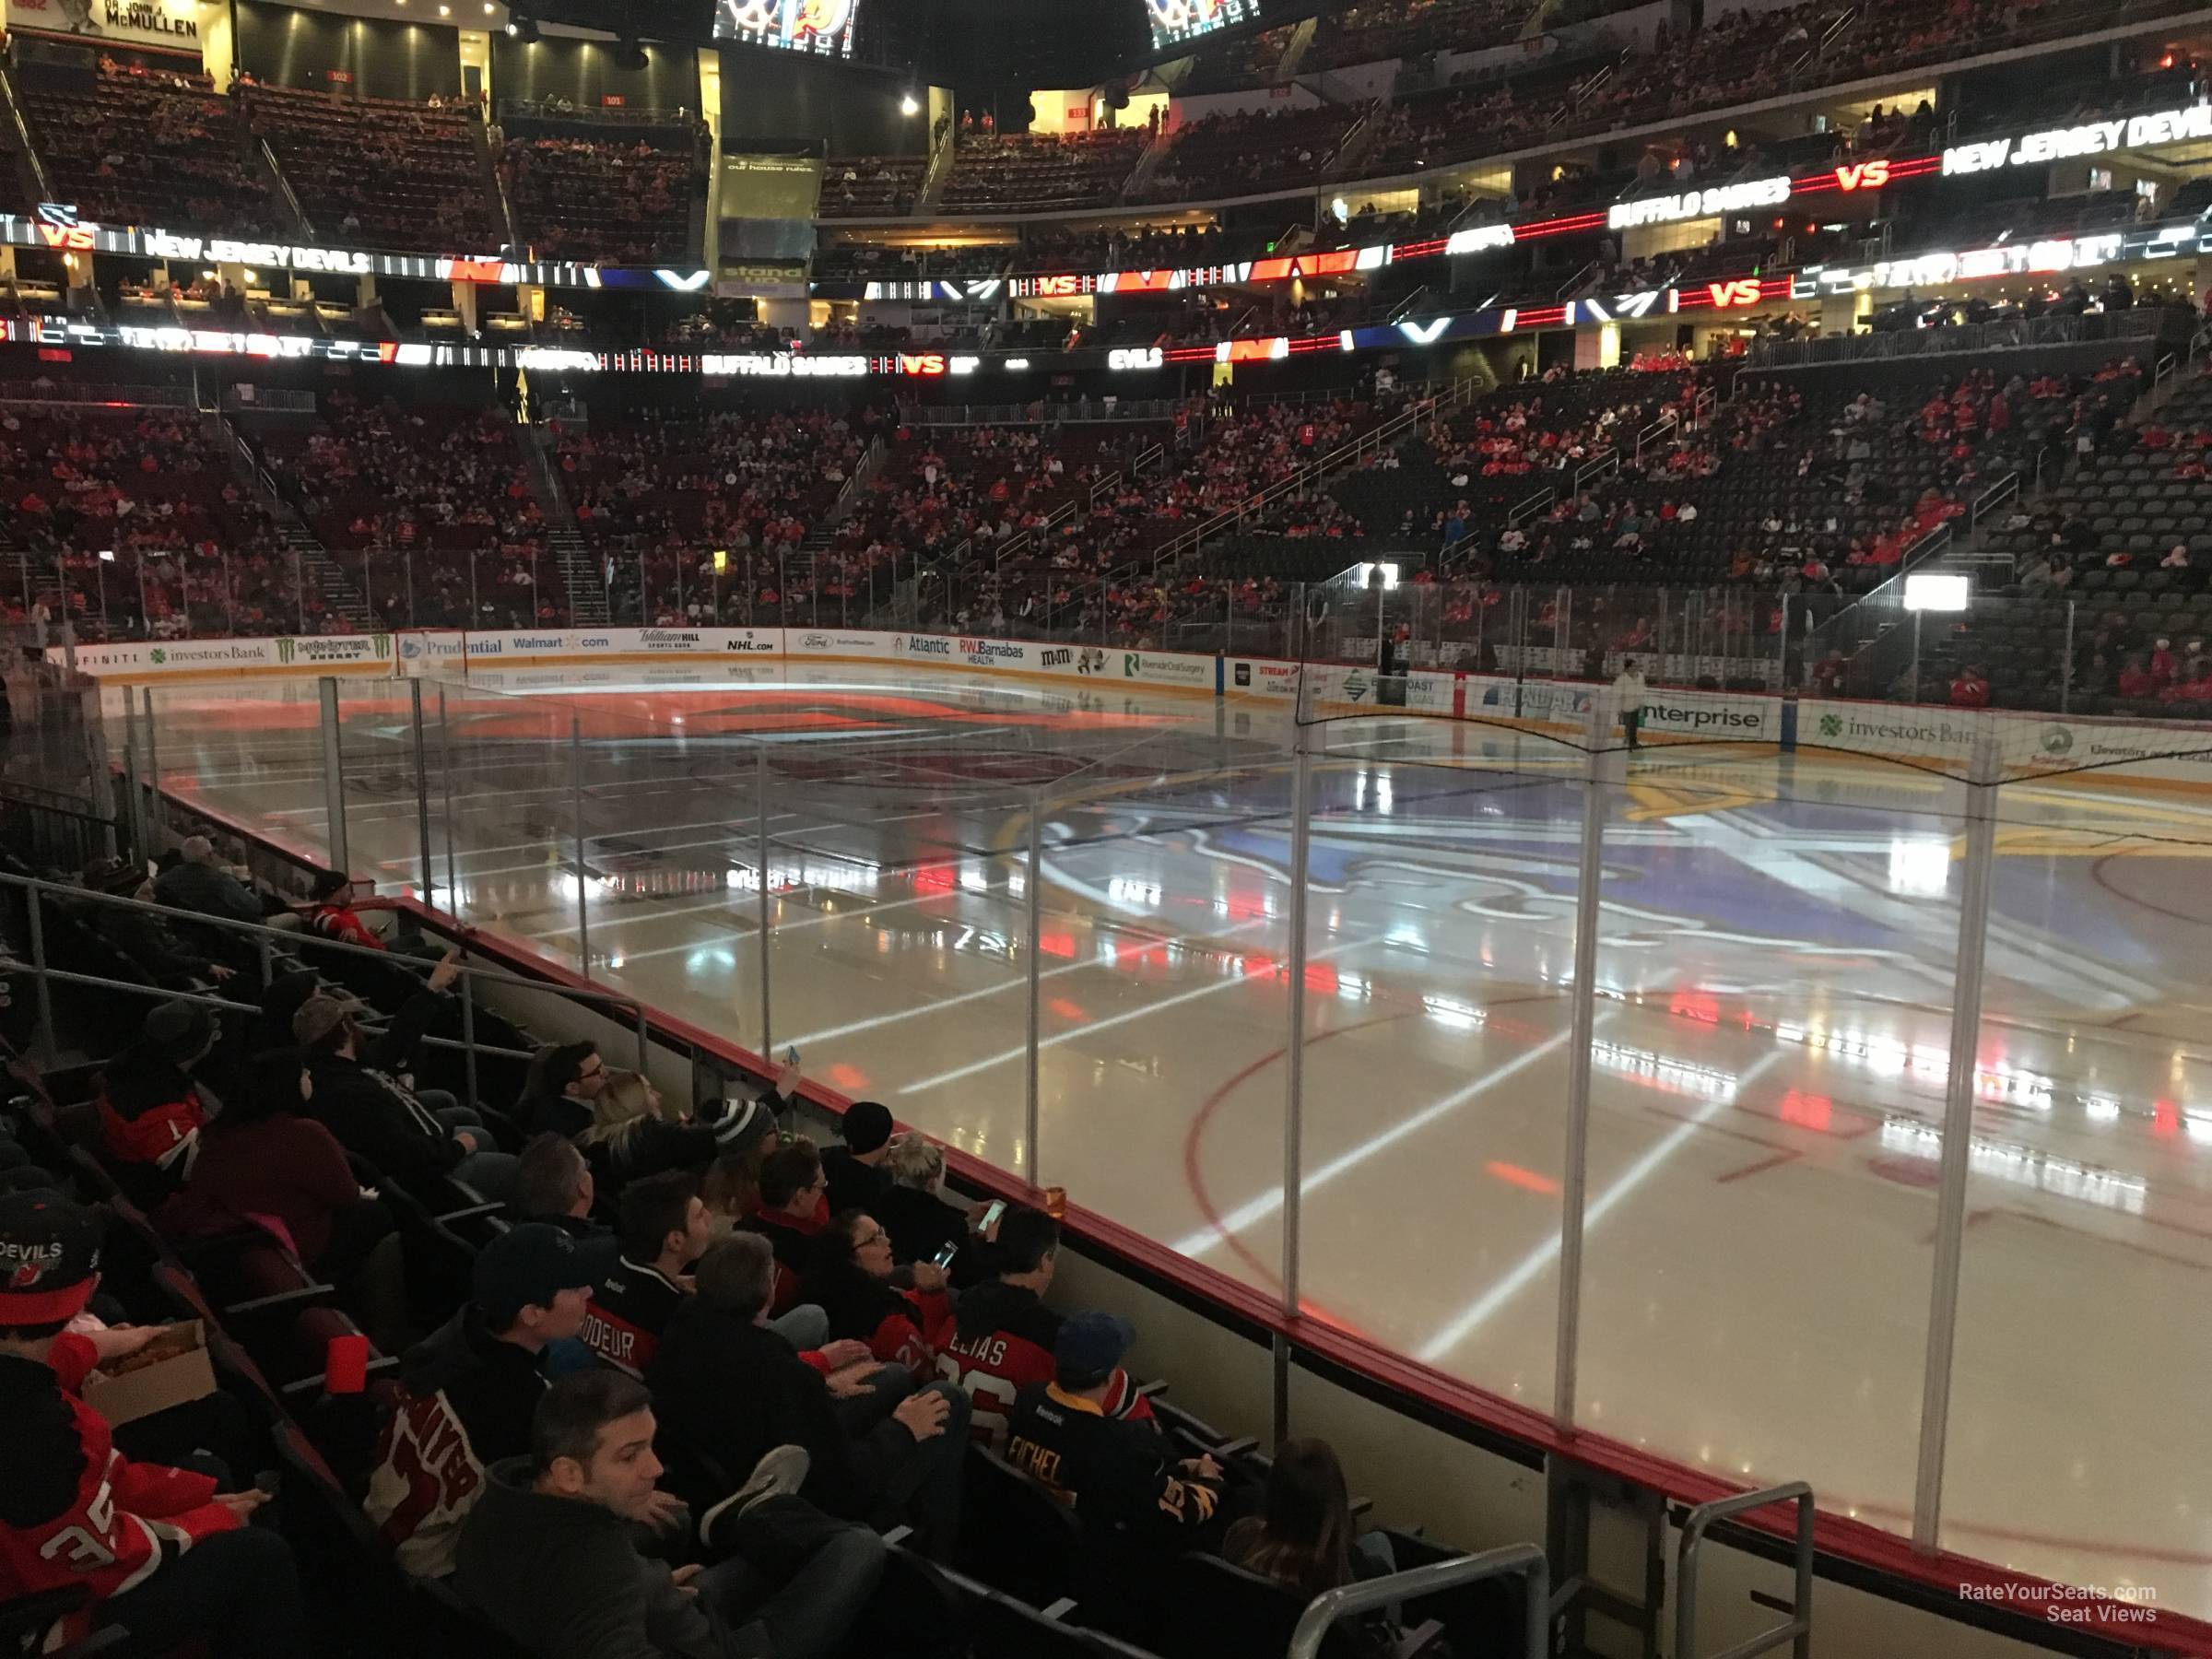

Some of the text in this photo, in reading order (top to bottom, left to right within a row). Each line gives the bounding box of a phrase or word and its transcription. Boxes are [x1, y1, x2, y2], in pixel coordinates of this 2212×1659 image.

[126, 2, 153, 14] JOHN
[333, 72, 348, 82] 102
[606, 97, 620, 105] 101
[1942, 104, 2212, 176] NEW JERSEY DEVIL
[748, 163, 783, 171] house
[785, 164, 815, 172] rules.
[1835, 160, 1890, 191] VS
[1609, 175, 1791, 229] BUFFALO SABRES
[33, 223, 94, 250] VS
[145, 234, 370, 274] NEW JERSEY DEVILS
[724, 265, 803, 276] stand
[1038, 276, 1076, 295] VS
[1709, 278, 1762, 309] VS
[701, 355, 867, 376] BUFFALO SABRES
[902, 355, 945, 374] VS
[1108, 347, 1163, 369] EVILS
[427, 639, 502, 654] Prudntial
[512, 637, 563, 650] Walmart
[681, 633, 700, 642] HILL
[909, 636, 950, 654] Atlantic
[968, 655, 994, 665] HEALTH
[1259, 666, 1288, 677] STREAM
[1406, 681, 1434, 692] OAST
[1643, 704, 1759, 728] nterprise
[581, 1313, 635, 1361] ODEUR
[1009, 1434, 1062, 1482] EICHEL
